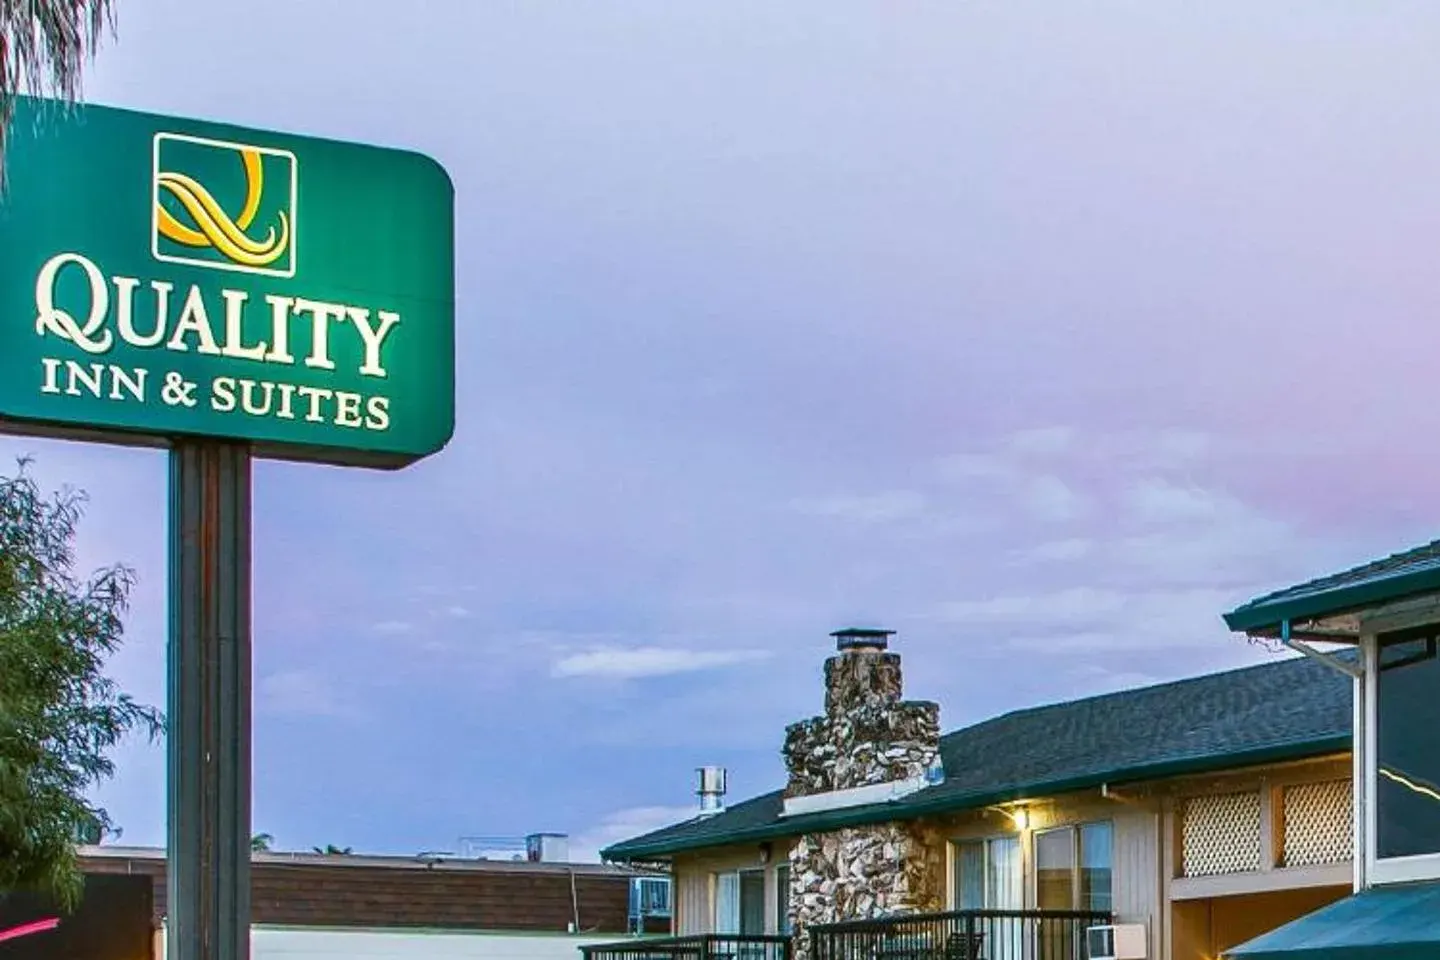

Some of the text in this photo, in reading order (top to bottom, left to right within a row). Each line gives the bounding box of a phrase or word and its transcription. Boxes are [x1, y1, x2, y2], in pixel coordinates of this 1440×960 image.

[35, 253, 400, 377] QUALITY
[41, 358, 390, 430] INN & SUITES
